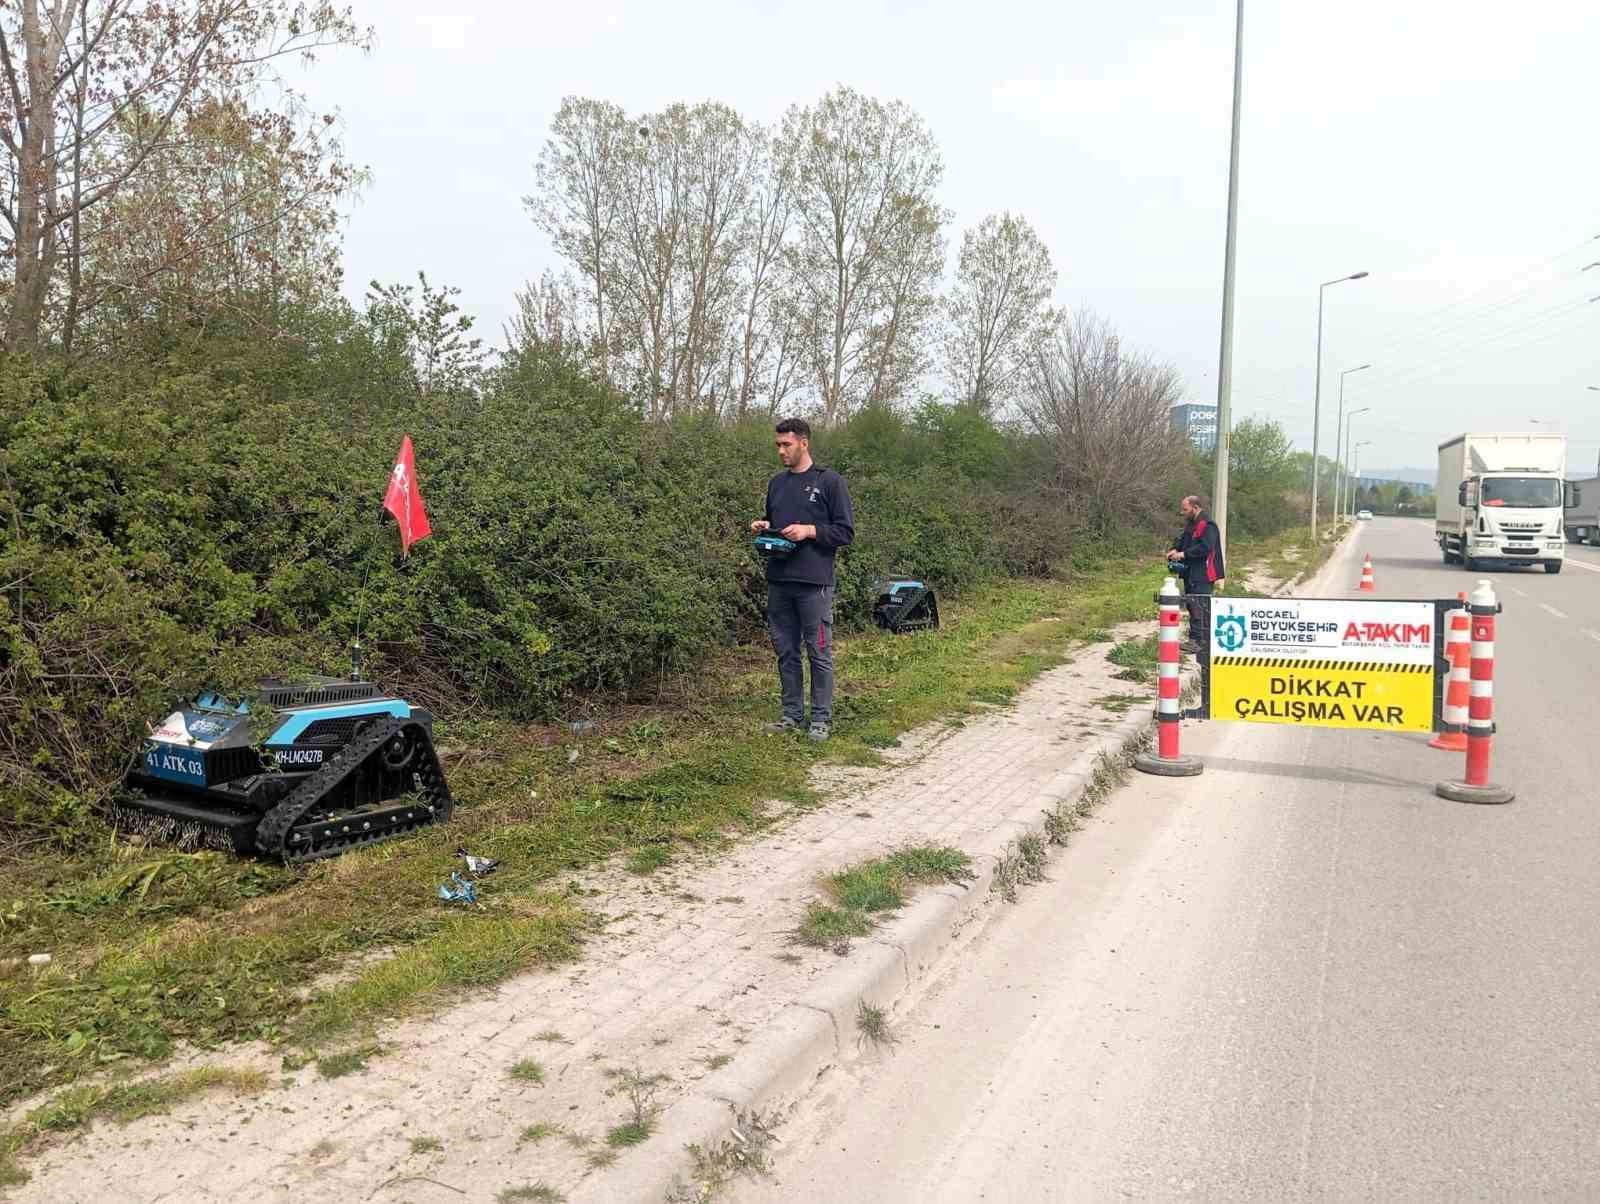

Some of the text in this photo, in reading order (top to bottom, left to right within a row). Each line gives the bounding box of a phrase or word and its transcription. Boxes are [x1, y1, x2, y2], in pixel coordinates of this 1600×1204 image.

[1251, 610, 1300, 619] KOCAELİ
[1251, 620, 1338, 632] BÜYÜKŞEHİR
[1343, 622, 1430, 643] A-TAKIMI
[1251, 632, 1316, 642] BELEDİYESİ
[1271, 675, 1366, 699] DİKKAT
[1235, 698, 1404, 724] ÇALIŞMA VAR
[147, 752, 203, 776] 41 ATK 03
[275, 750, 323, 764] KH-LM2427B
